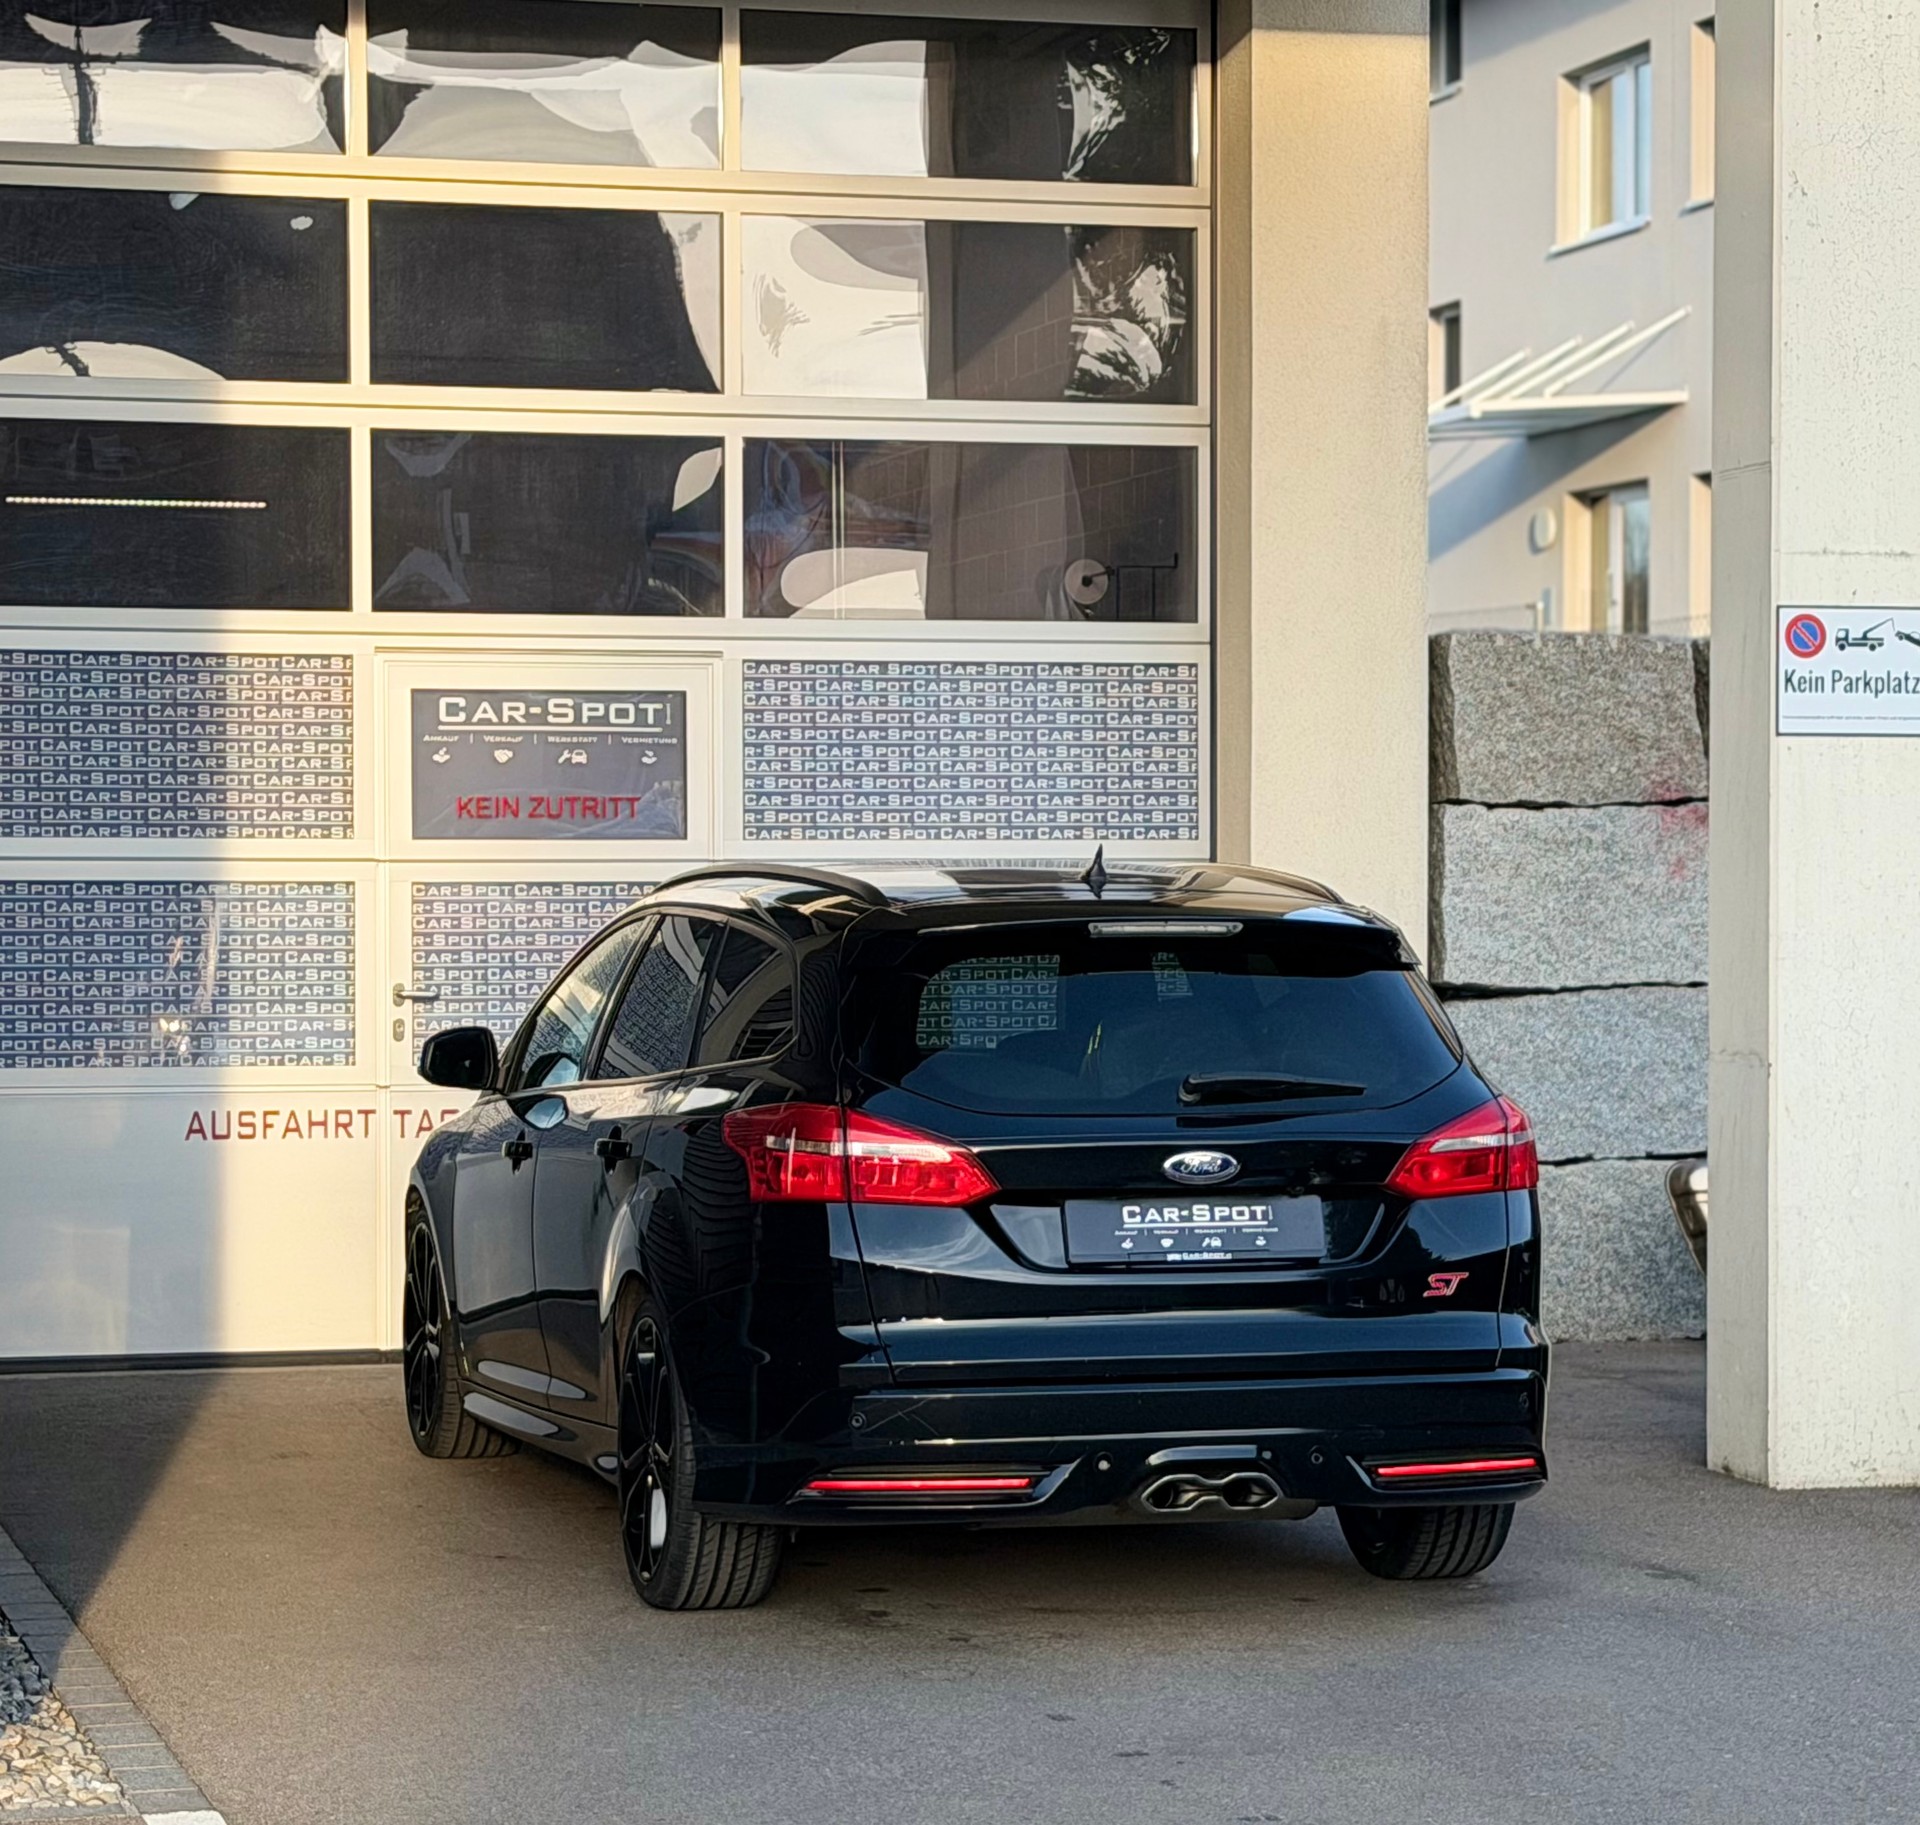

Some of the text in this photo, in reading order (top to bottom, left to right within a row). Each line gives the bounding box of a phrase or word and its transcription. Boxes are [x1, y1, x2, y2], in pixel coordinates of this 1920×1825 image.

[1784, 668, 1920, 699] Kein Parkplatz
[438, 697, 663, 725] CAR-SPOT
[456, 796, 642, 819] KEIN ZUTRITT
[185, 1109, 377, 1141] AUSFAHRT
[1122, 1204, 1267, 1223] CAR-SPOT
[1423, 1271, 1470, 1298] ST
